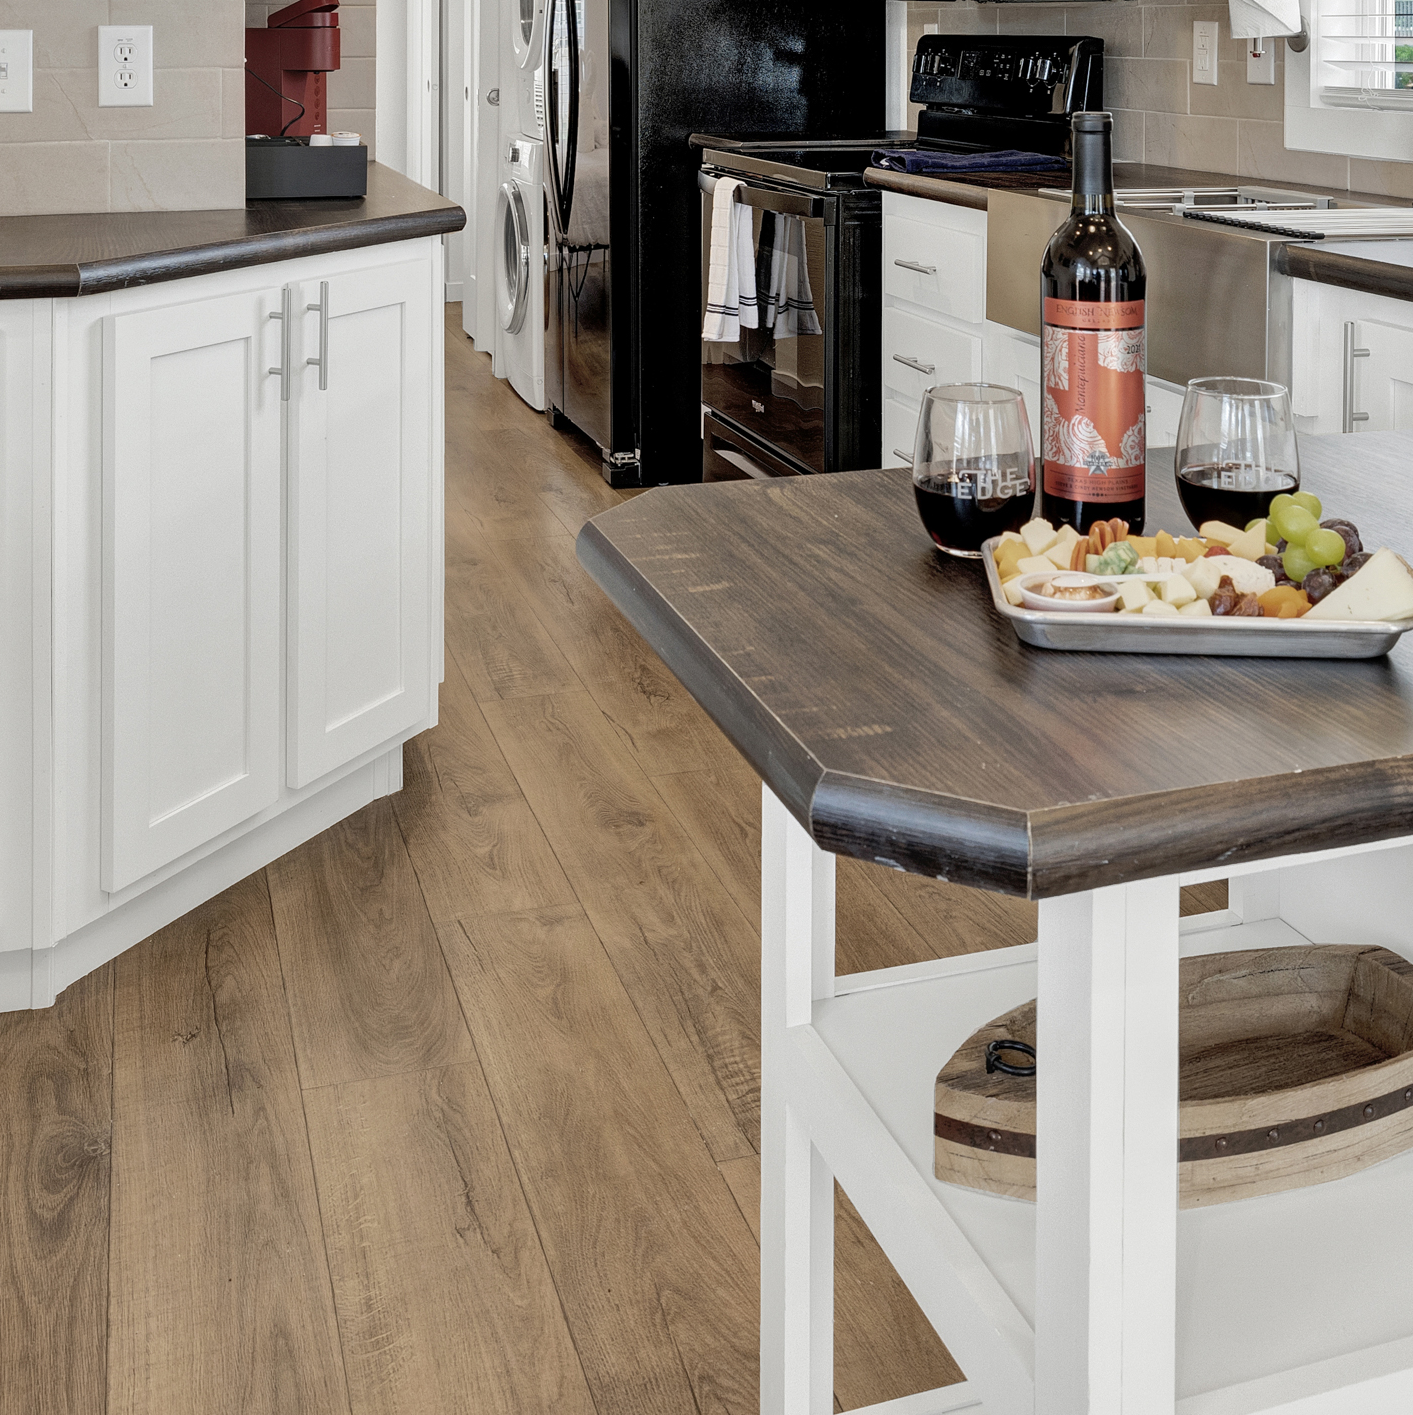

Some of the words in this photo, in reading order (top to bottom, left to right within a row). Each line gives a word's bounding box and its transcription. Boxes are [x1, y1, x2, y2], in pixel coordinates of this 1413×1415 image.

[1056, 304, 1094, 317] ENGLISH
[1099, 306, 1137, 317] NEWSOM
[959, 468, 1030, 485] THE
[957, 482, 1027, 500] EDGE
